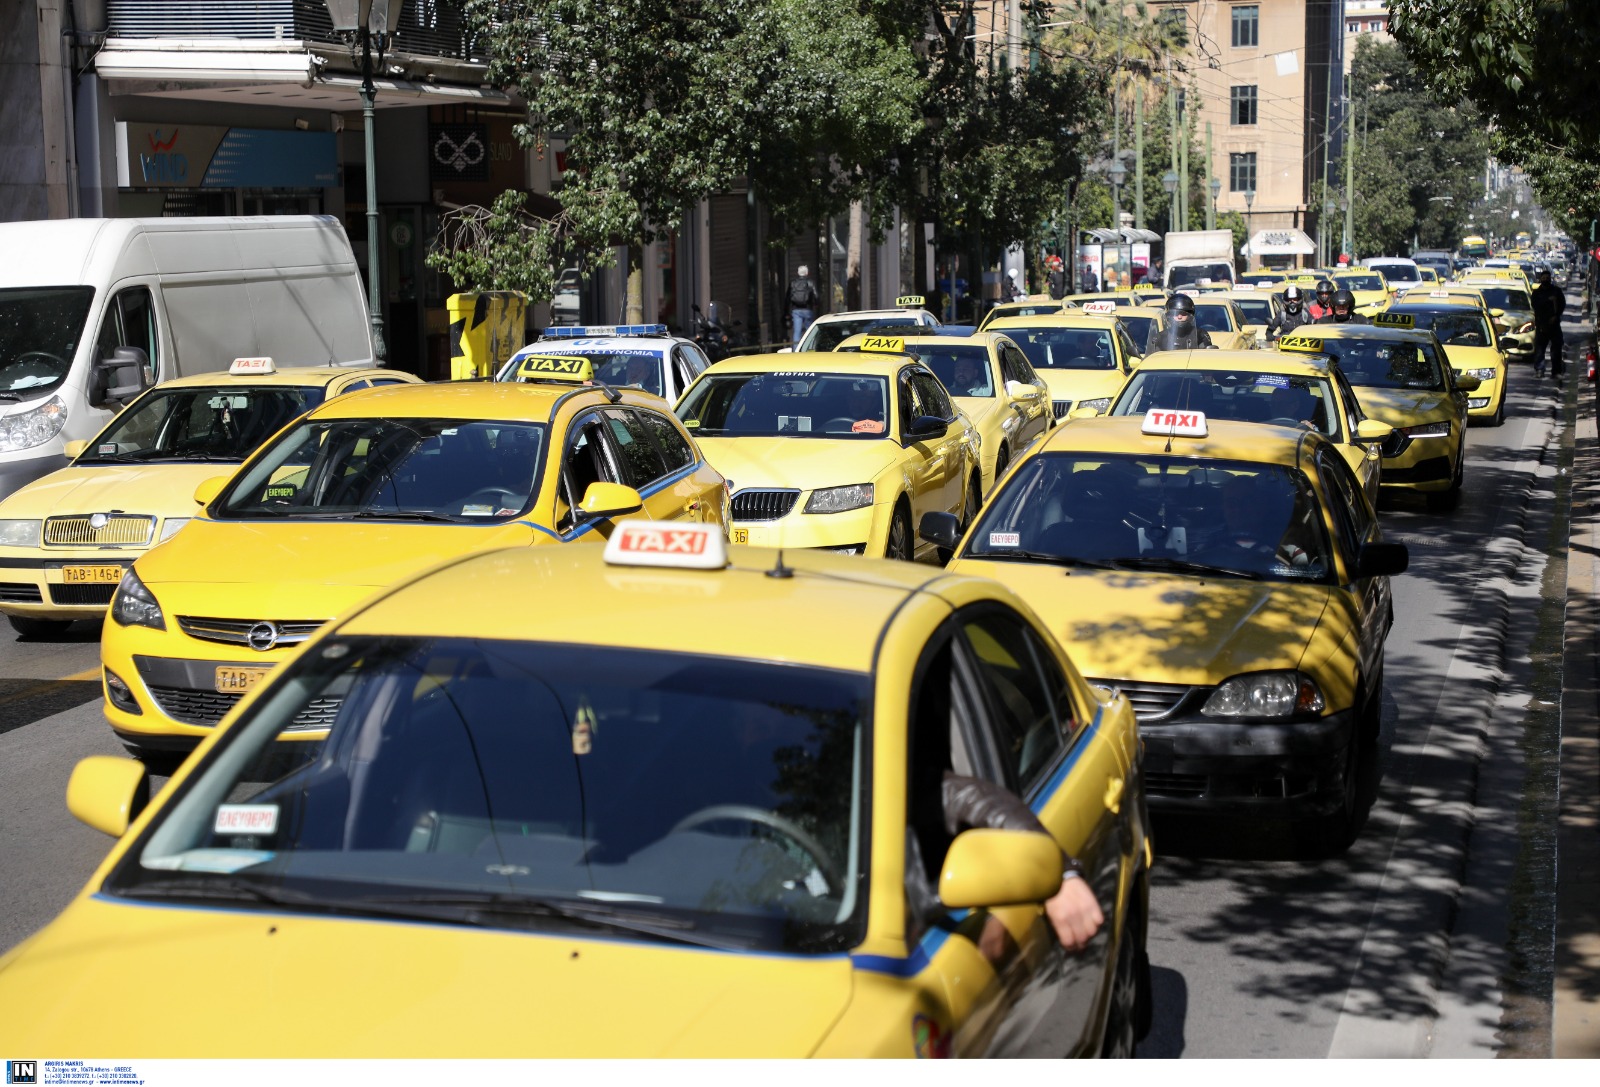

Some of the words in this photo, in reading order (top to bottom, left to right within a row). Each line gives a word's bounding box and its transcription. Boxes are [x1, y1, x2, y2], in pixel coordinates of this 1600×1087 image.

[140, 152, 188, 183] WIND
[1380, 314, 1409, 323] TAXI
[864, 338, 899, 348] TAXI
[1283, 337, 1319, 348] TAXI
[530, 358, 582, 373] TAXI
[1152, 413, 1199, 427] TAXI
[625, 530, 704, 554] TAXI
